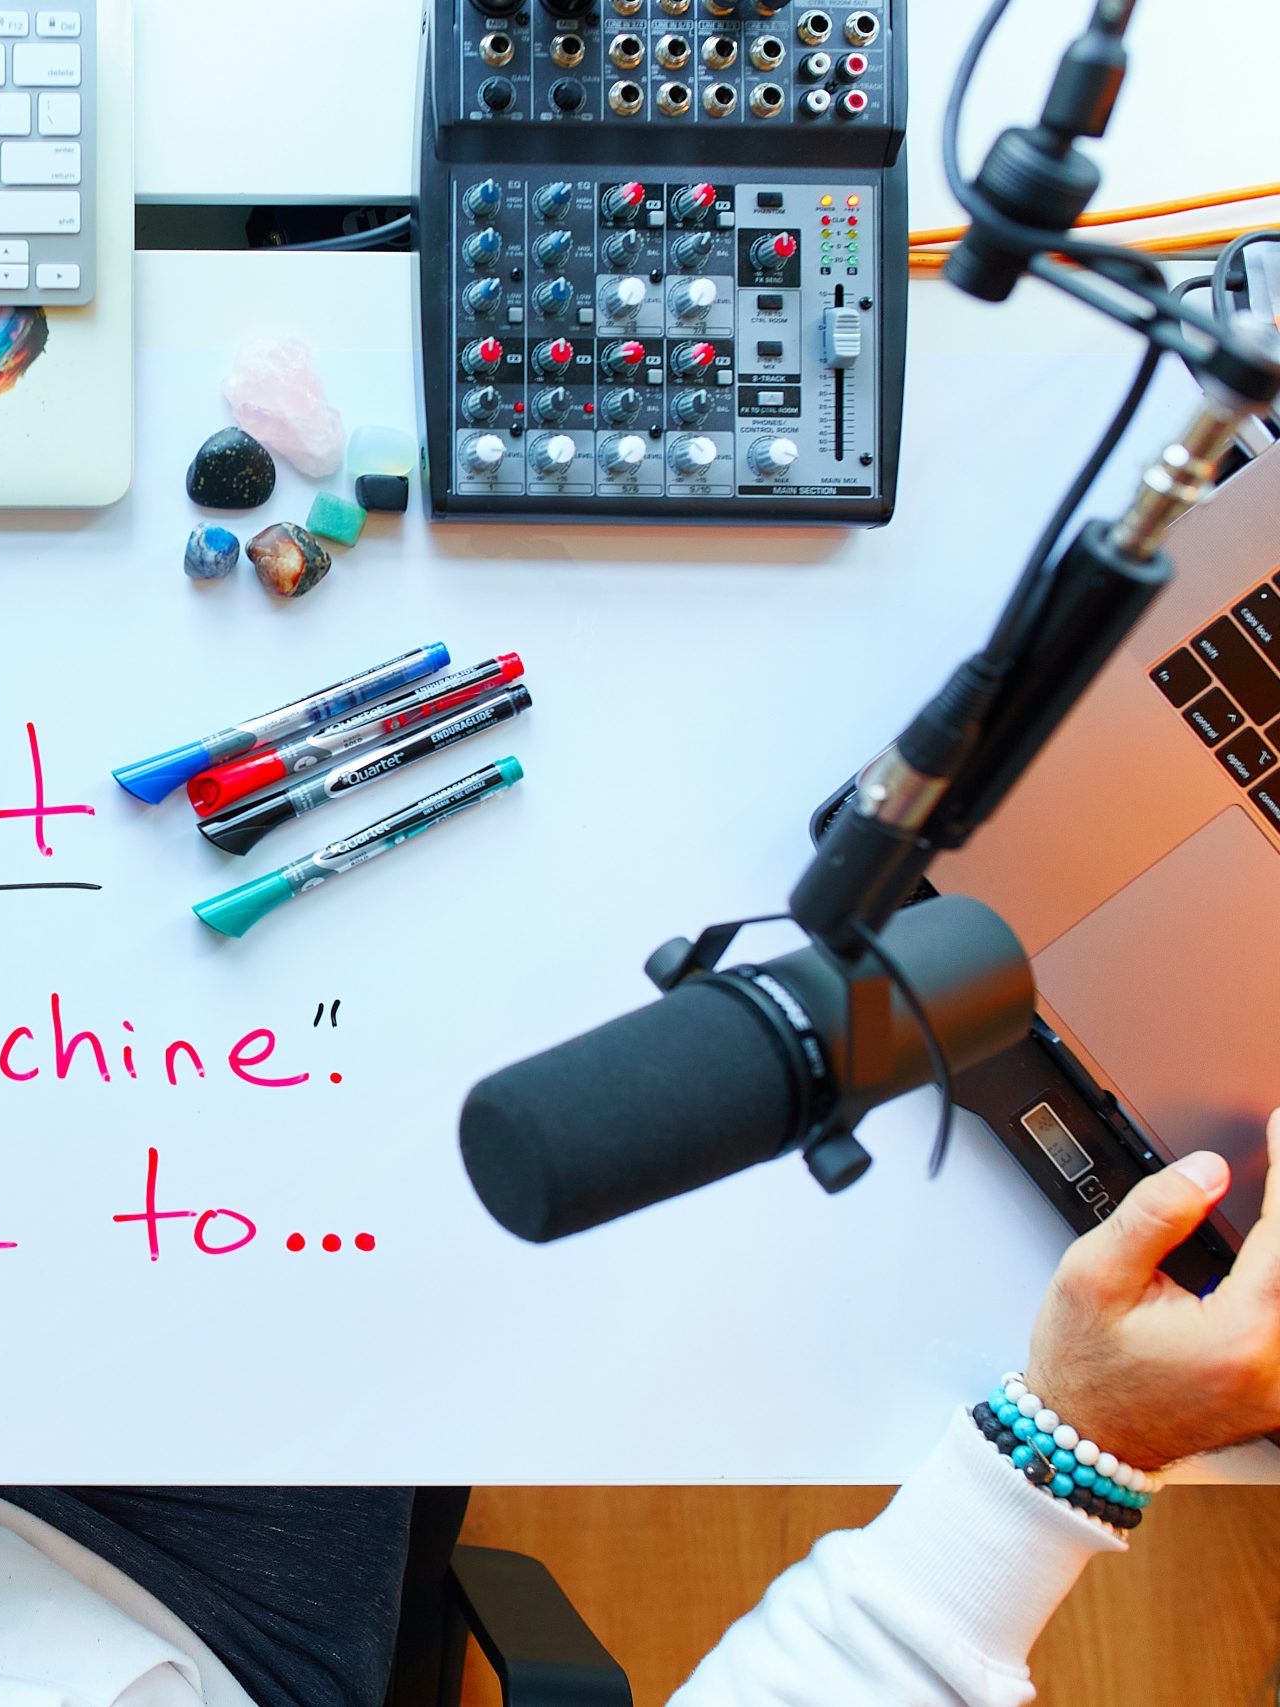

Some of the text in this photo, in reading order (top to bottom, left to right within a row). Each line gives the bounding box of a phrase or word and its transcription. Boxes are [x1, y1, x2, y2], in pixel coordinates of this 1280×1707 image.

[772, 487, 837, 495] MAIN SECTION
[430, 708, 495, 743] ENDURAGLIDE
[347, 753, 404, 786] Quartet
[338, 822, 392, 854] Quartet
[113, 1147, 375, 1262] to...
